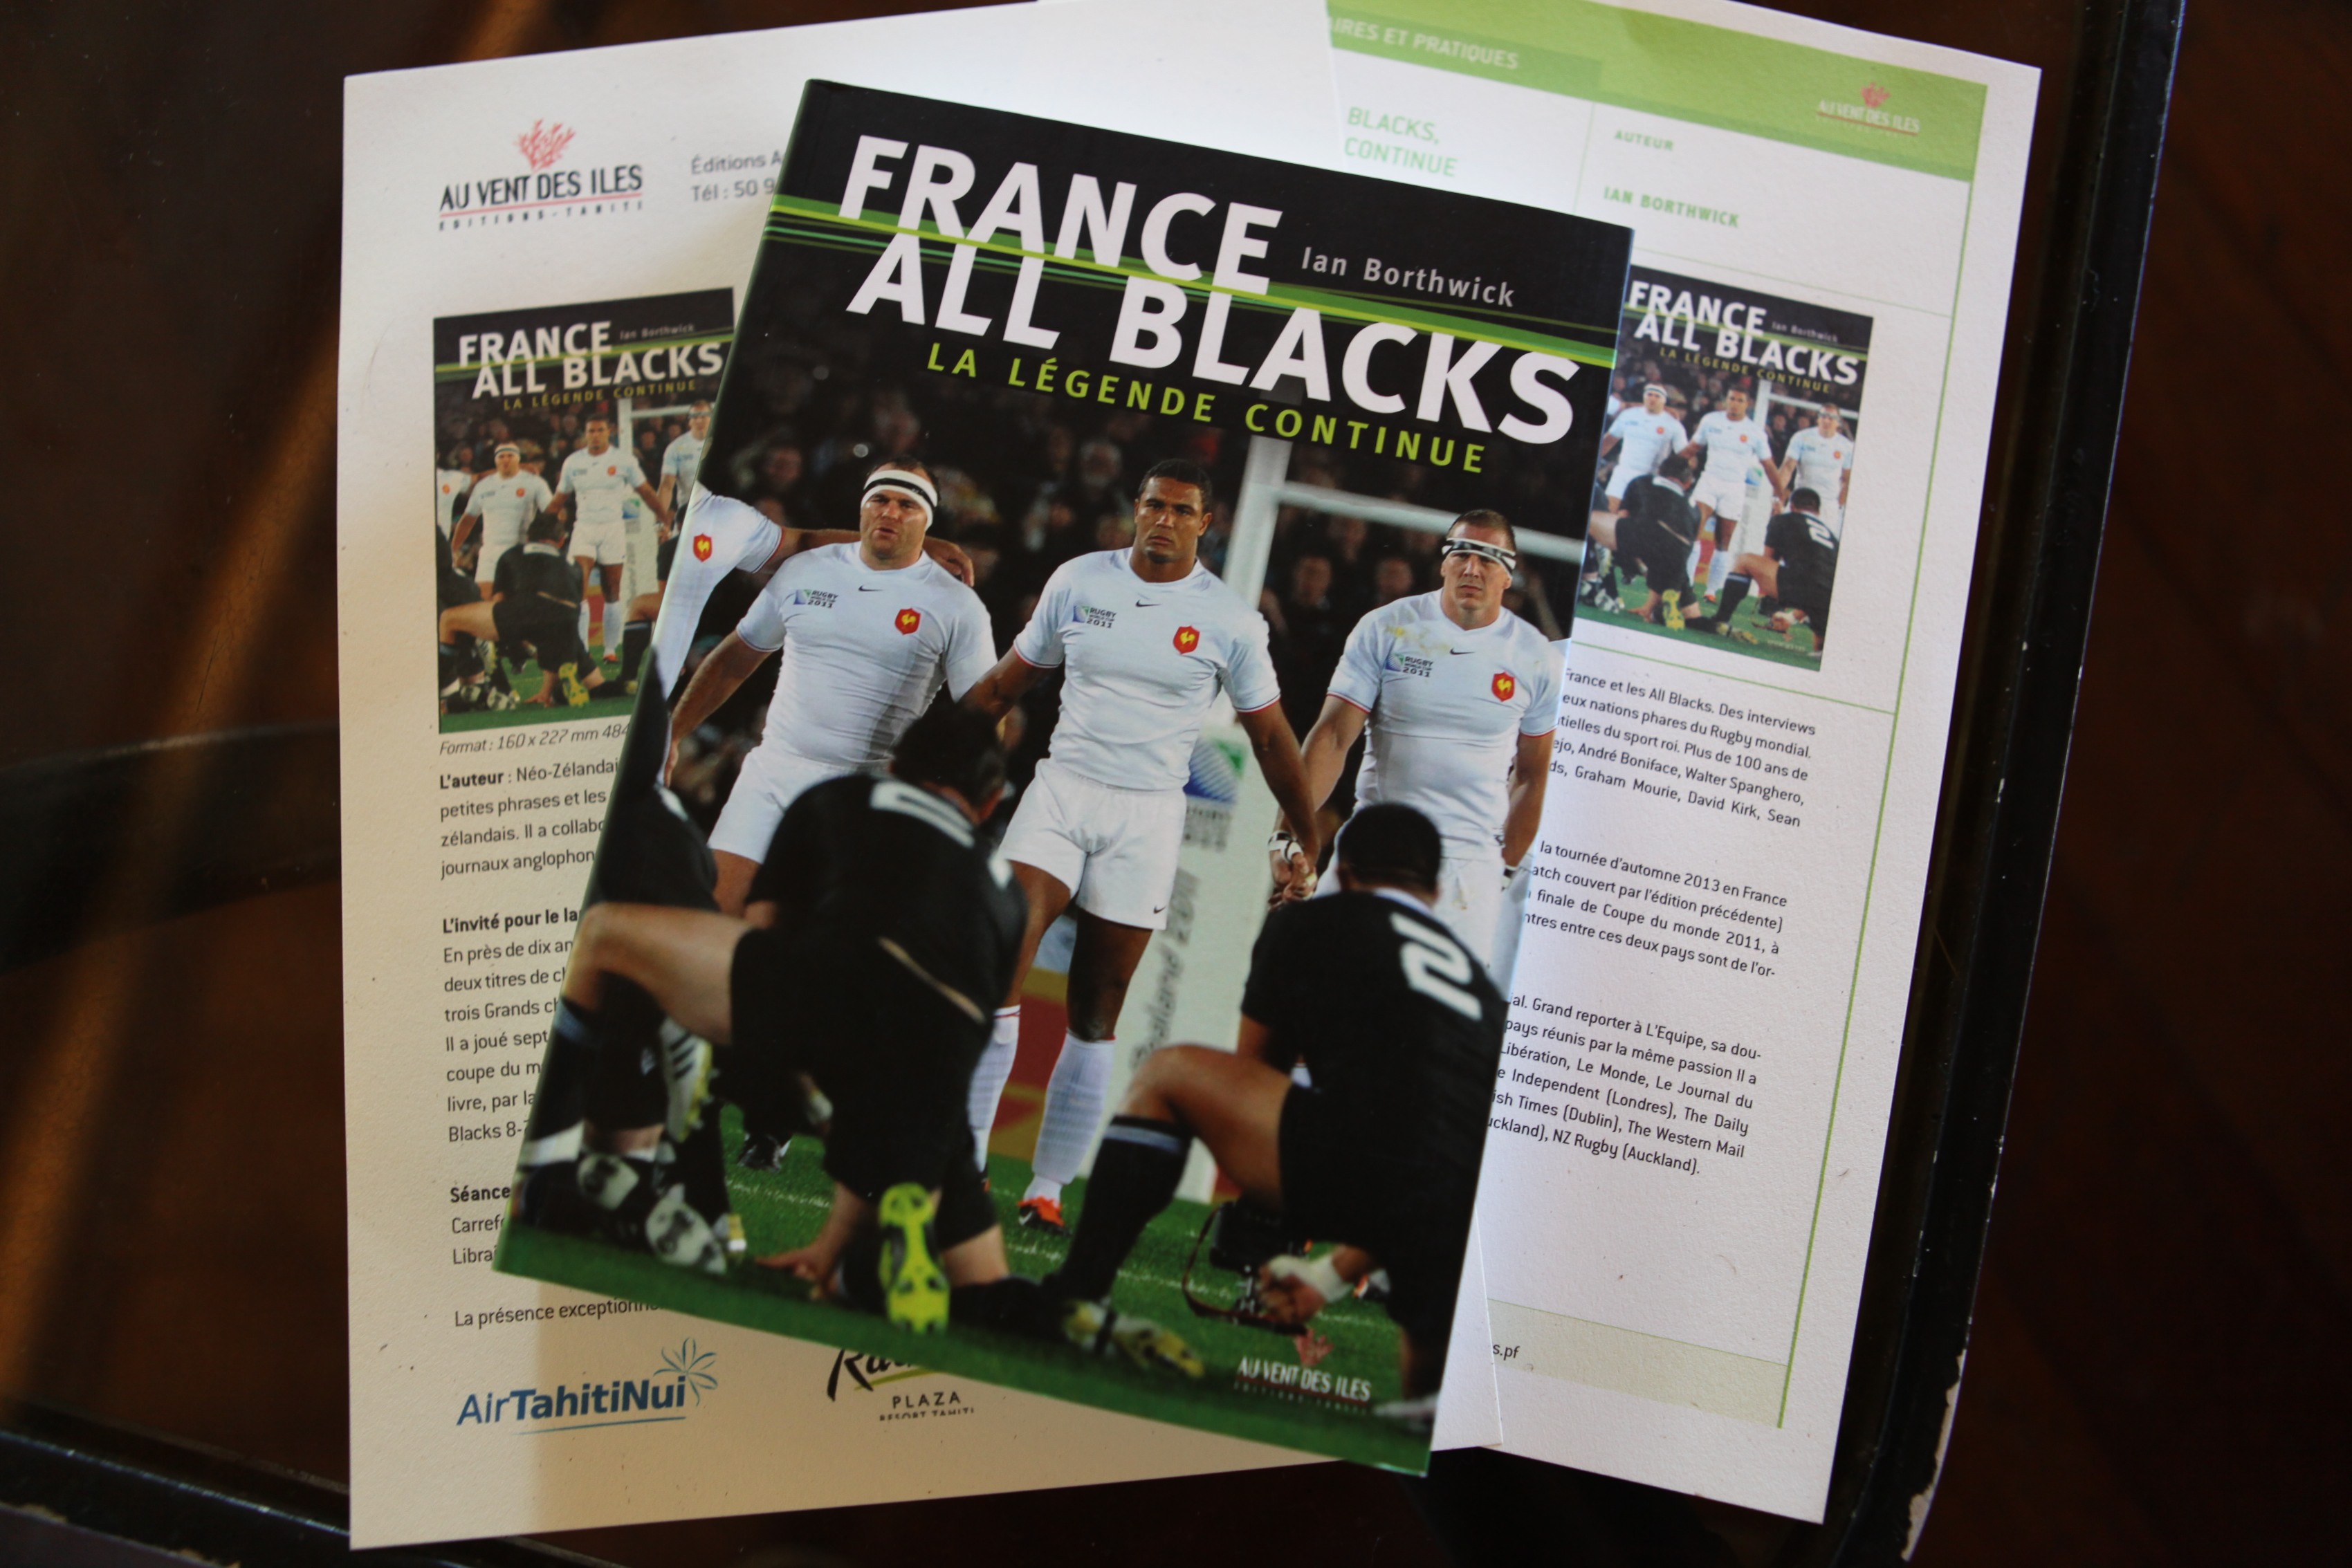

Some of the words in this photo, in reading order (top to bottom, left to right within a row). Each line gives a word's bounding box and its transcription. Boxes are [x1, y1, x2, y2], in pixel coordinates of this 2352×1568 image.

[1384, 27, 1409, 46] ET
[1413, 33, 1519, 70] PRATIQUES
[1347, 106, 1440, 145] BLACKS,
[1615, 129, 1675, 151] AUTEUR
[691, 153, 766, 175] Éditions
[1343, 136, 1458, 178] CONTINUE
[439, 183, 470, 212] AU
[477, 175, 530, 207] VENT
[538, 170, 580, 200] DES
[591, 164, 643, 192] ILES
[690, 183, 718, 203] Tél
[734, 178, 758, 198] 50
[838, 134, 1283, 295] FRANCE
[1604, 185, 1634, 204] IAN
[1639, 194, 1740, 228] BORTHWICK
[1301, 246, 1347, 276] Ian
[1363, 258, 1516, 308] Borthwick
[1628, 280, 1767, 336] FRANCE
[459, 321, 612, 367] FRANCE
[619, 329, 636, 340] Ian
[641, 323, 695, 338] Borthwick
[845, 232, 1060, 350] ALL
[1109, 275, 1581, 445] BLACKS
[1772, 320, 1788, 332] Ian
[1790, 324, 1839, 344] Borthwick
[1634, 313, 1701, 351] ALL
[1715, 328, 1859, 386] BLACKS
[472, 361, 546, 400] ALL
[563, 341, 724, 389] BLACKS
[1660, 347, 1677, 359] LA
[1684, 350, 1749, 375] LÉGENDE
[1756, 368, 1831, 394] CONTINUE
[504, 396, 522, 411] LA
[532, 388, 604, 408] LÉGENDE
[613, 379, 696, 398] CONTINUE
[927, 343, 977, 378] LA
[1008, 357, 1216, 423] LÉGENDE
[1245, 403, 1486, 474] CONTINUE
[807, 599, 834, 609] 2011
[812, 590, 838, 599] RUGBY
[1087, 618, 1112, 629] 2011
[1090, 607, 1117, 618] RUGBY
[1403, 667, 1430, 677] 2011
[1405, 656, 1433, 667] RUGBY
[1610, 682, 1623, 692] et
[1626, 683, 1645, 697] les
[1649, 688, 1665, 701] All
[1669, 692, 1714, 713] Blacks.
[1719, 703, 1743, 719] Des
[1747, 710, 1815, 735] interviews
[1563, 694, 1586, 707] eux
[1590, 701, 1638, 719] nations
[1642, 711, 1687, 730] phares
[1691, 721, 1707, 735] du
[1711, 725, 1752, 748] Rugby
[1755, 738, 1810, 758] mondial.
[440, 740, 487, 755] Format
[497, 734, 526, 750] 160
[540, 730, 568, 745] 227
[571, 731, 598, 741] mm
[440, 773, 504, 789] L'auteur
[1575, 766, 1626, 788] Graham
[1633, 779, 1680, 802] Mourie,
[1688, 791, 1725, 810] David
[1731, 801, 1760, 820] Kirk,
[1767, 809, 1800, 827] Sean
[441, 803, 493, 822] petites
[499, 796, 560, 817] phrases
[564, 793, 579, 806] et
[585, 790, 606, 803] les
[442, 828, 519, 847] zélandais.
[525, 824, 532, 838] Il
[538, 827, 546, 837] a
[441, 859, 508, 880] journaux
[1541, 840, 1552, 854] la
[1556, 846, 1607, 866] tournée
[1610, 857, 1680, 883] d'automne
[1684, 873, 1720, 892] 2013
[1723, 885, 1739, 896] en
[1743, 886, 1787, 907] France
[1565, 874, 1616, 893] couvert
[1618, 886, 1642, 898] par
[1644, 889, 1697, 912] l'édition
[443, 913, 499, 934] L'invité
[505, 914, 541, 933] pour
[545, 909, 559, 924] le
[564, 907, 580, 922] la
[444, 948, 463, 963] En
[468, 945, 502, 965] près
[506, 942, 524, 957] de
[529, 939, 551, 954] dix
[1388, 910, 1482, 1021] 2
[445, 977, 481, 992] deux
[485, 973, 526, 988] titres
[531, 969, 549, 984] de
[445, 1005, 479, 1022] trois
[485, 1000, 540, 1018] Grands
[446, 1037, 454, 1051] Il
[460, 1040, 468, 1050] a
[474, 1032, 507, 1054] joué
[1543, 1027, 1586, 1046] réunis
[1589, 1039, 1613, 1052] par
[1615, 1042, 1627, 1055] la
[1632, 1049, 1675, 1066] même
[1678, 1059, 1732, 1079] passion
[1737, 1069, 1745, 1082] Il
[1749, 1075, 1756, 1085] a
[1519, 1096, 1558, 1116] Times
[1628, 1120, 1651, 1136] The
[1657, 1126, 1711, 1150] Western
[1716, 1140, 1745, 1158] Mail
[1553, 1129, 1572, 1145] NZ
[1574, 1134, 1618, 1159] Rugby
[450, 1185, 511, 1203] Séance
[455, 1311, 473, 1327] La
[479, 1307, 554, 1329] présence
[1238, 1356, 1260, 1378] AU
[1263, 1359, 1300, 1385] VENT
[1301, 1367, 1331, 1394] DES
[1335, 1374, 1371, 1402] ILES
[456, 1375, 686, 1426] AirTahitiNui
[892, 1391, 960, 1409] PLAZA
